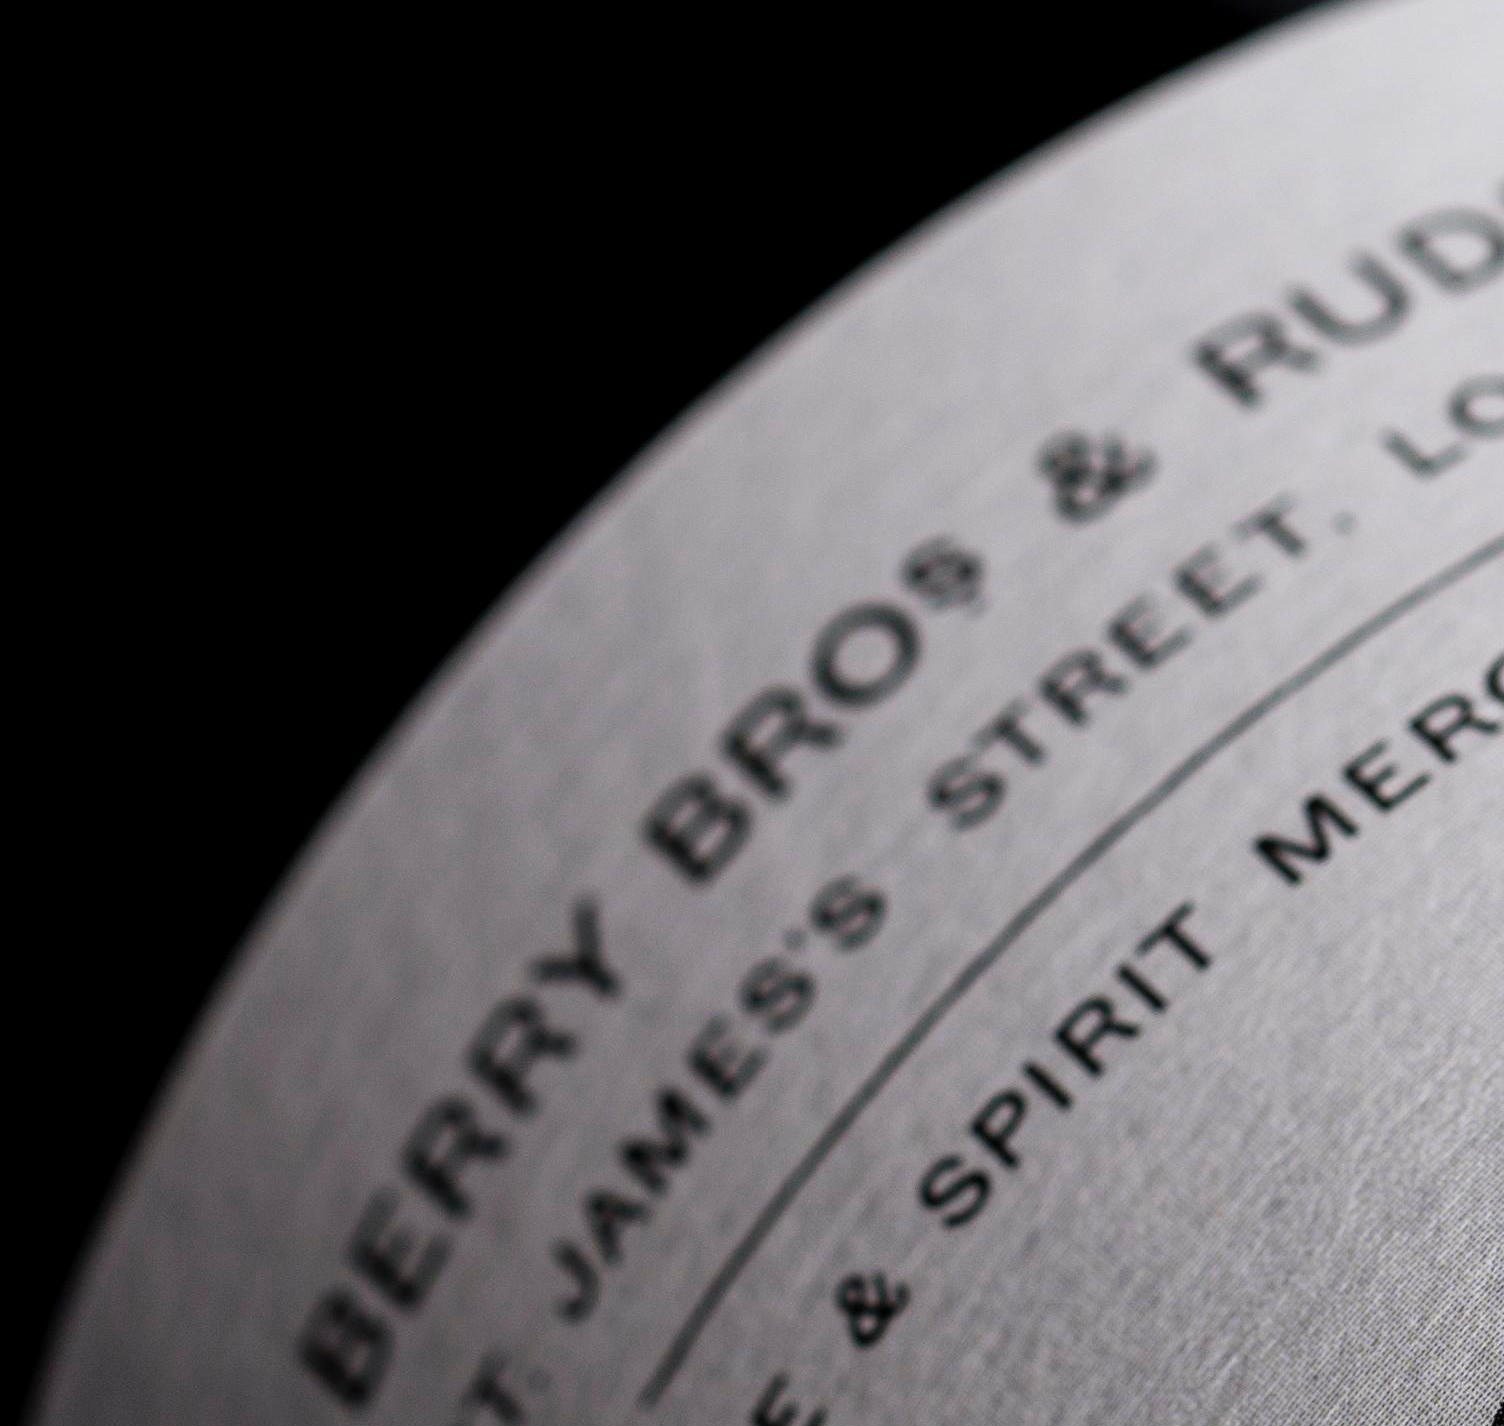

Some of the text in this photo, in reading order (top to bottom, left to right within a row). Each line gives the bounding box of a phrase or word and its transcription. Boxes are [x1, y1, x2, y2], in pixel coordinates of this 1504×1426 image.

[296, 890, 625, 1414] BERRY
[1035, 423, 1160, 525] &
[833, 1270, 912, 1350] &
[915, 899, 1218, 1231] SPIRIT
